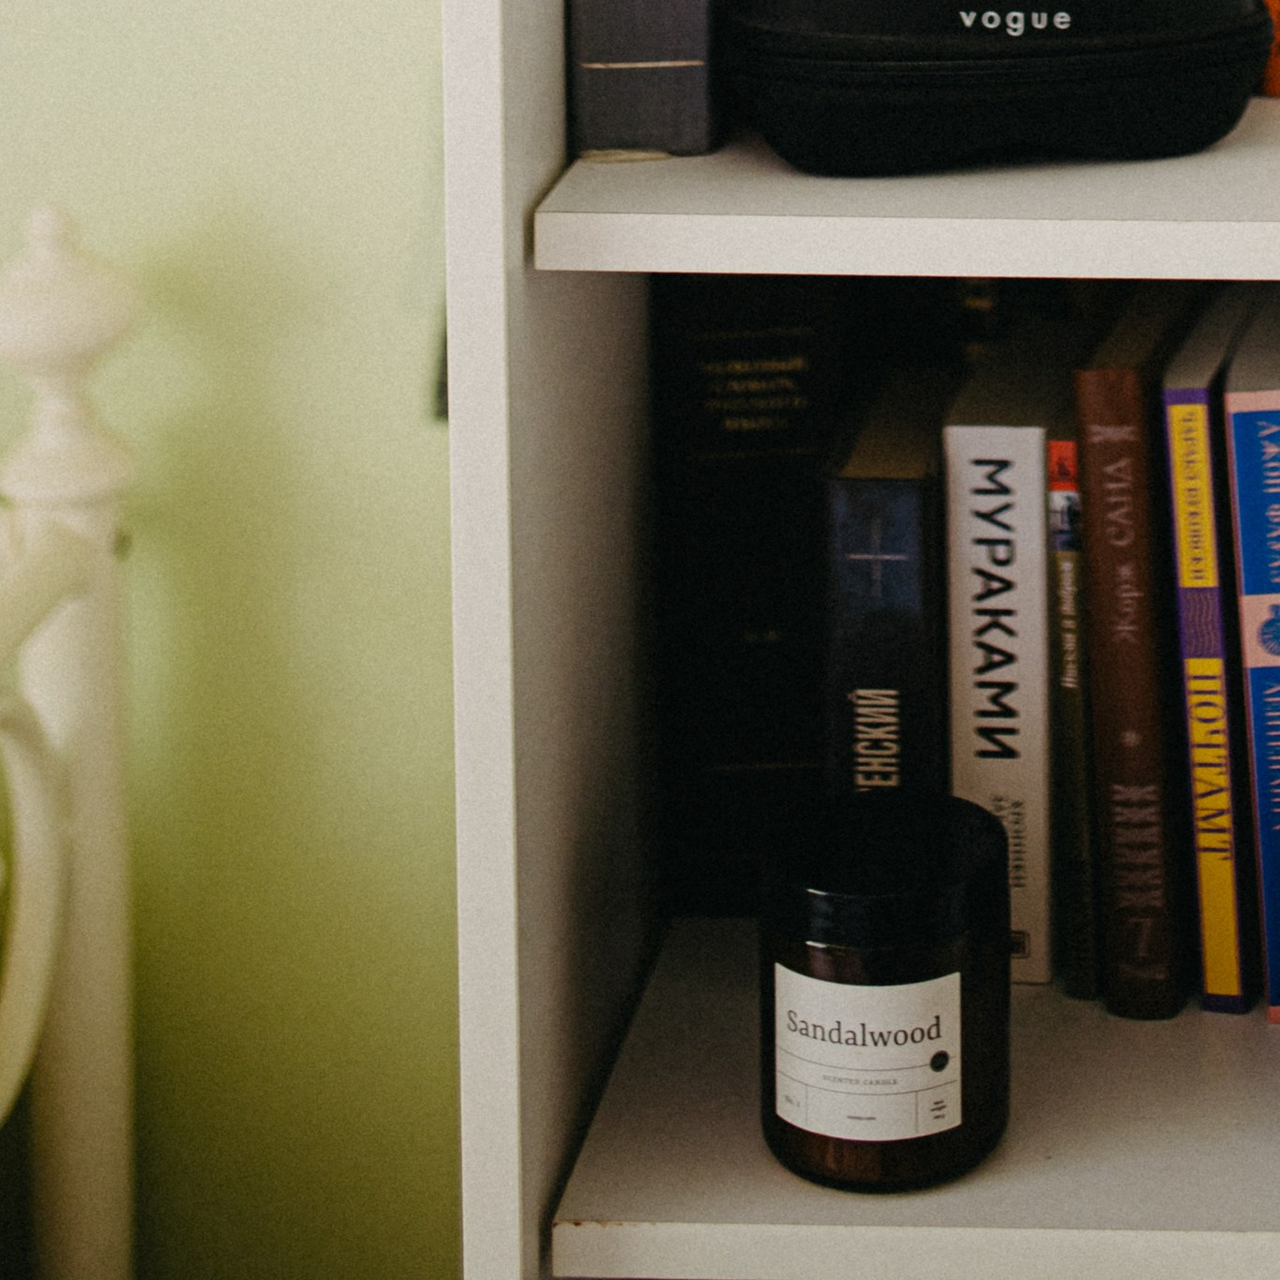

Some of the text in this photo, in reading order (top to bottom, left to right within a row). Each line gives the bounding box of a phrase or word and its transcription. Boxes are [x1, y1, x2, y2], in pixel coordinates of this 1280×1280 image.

[958, 9, 1073, 37] vogue
[970, 458, 1022, 761] МУРАКАМИ
[848, 686, 902, 793] ЕНСКИЙ
[1188, 674, 1233, 861] ПОЧТАМТ
[786, 1009, 943, 1048] Sandalwood
